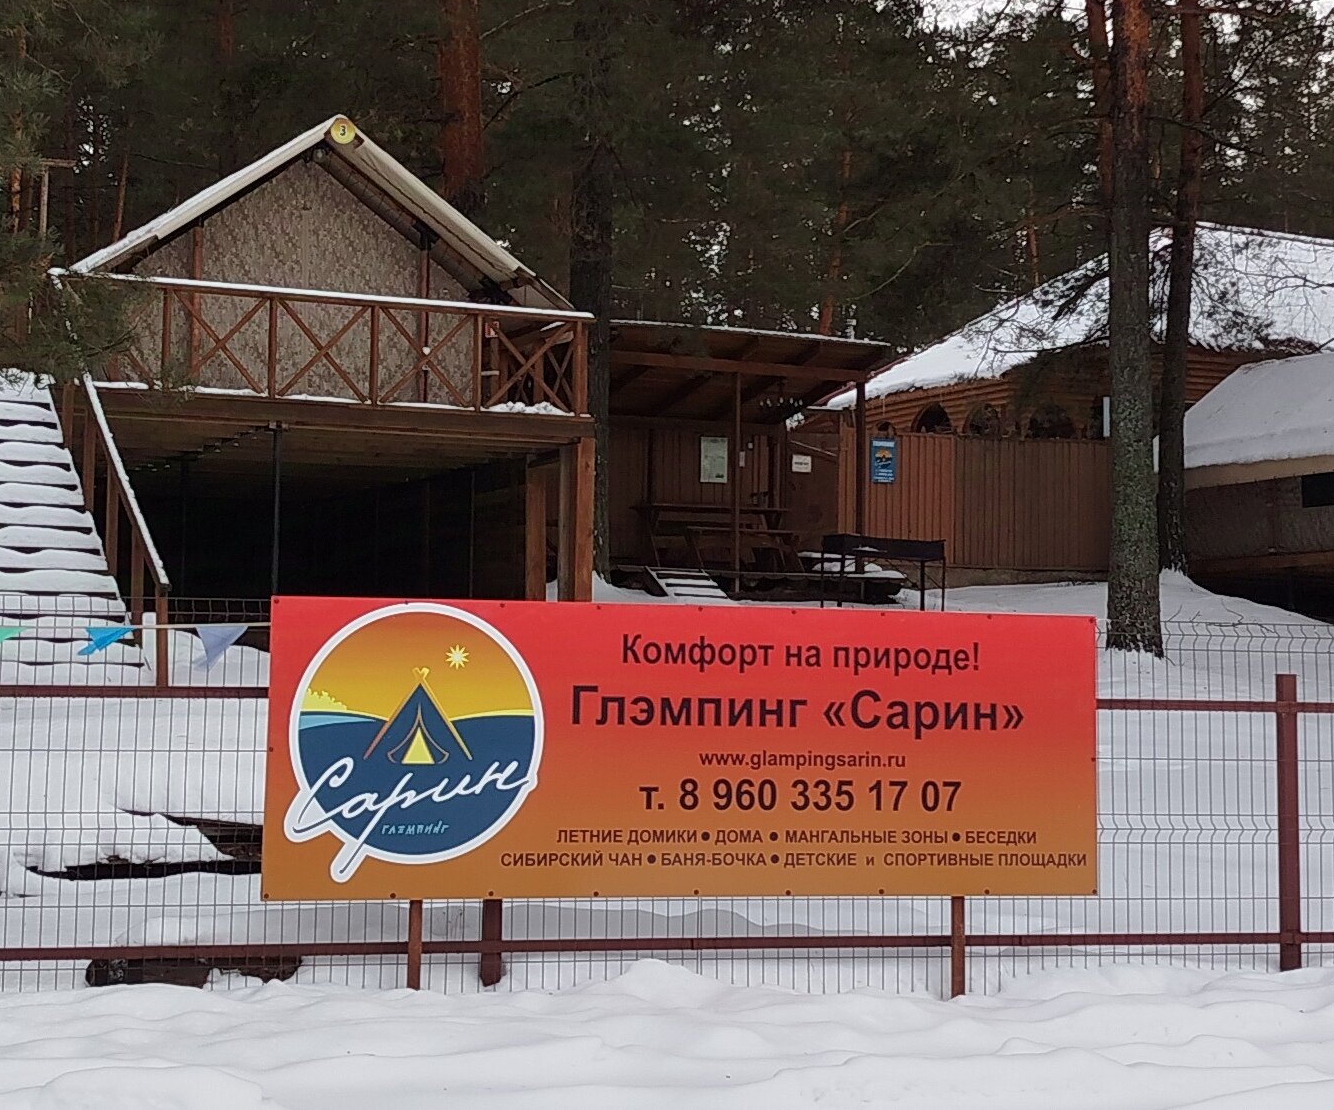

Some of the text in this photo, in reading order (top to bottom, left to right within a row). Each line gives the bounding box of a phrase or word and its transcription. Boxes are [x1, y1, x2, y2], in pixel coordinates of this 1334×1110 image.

[621, 633, 980, 676] Комфорт на природе!
[571, 685, 1024, 740] Глэмпинг «Сарин»
[699, 749, 906, 770] www.glampingsarin.ru
[639, 778, 962, 812] т. 8 960 335 17 07
[292, 757, 529, 874] Сарин
[556, 830, 1037, 847] ЛЕТНИЕ ДОМИКИ ДОМА МАНГАЛЬНЫЕ ЗОНЫ БЕСЕДКИ
[500, 850, 1088, 869] СИБИРСКИЙ ЧАН БАНЯ-БОЧКА ДЕТСКИЕ и СПОРТИВНЫЕ ПЛОЩАДКИ
